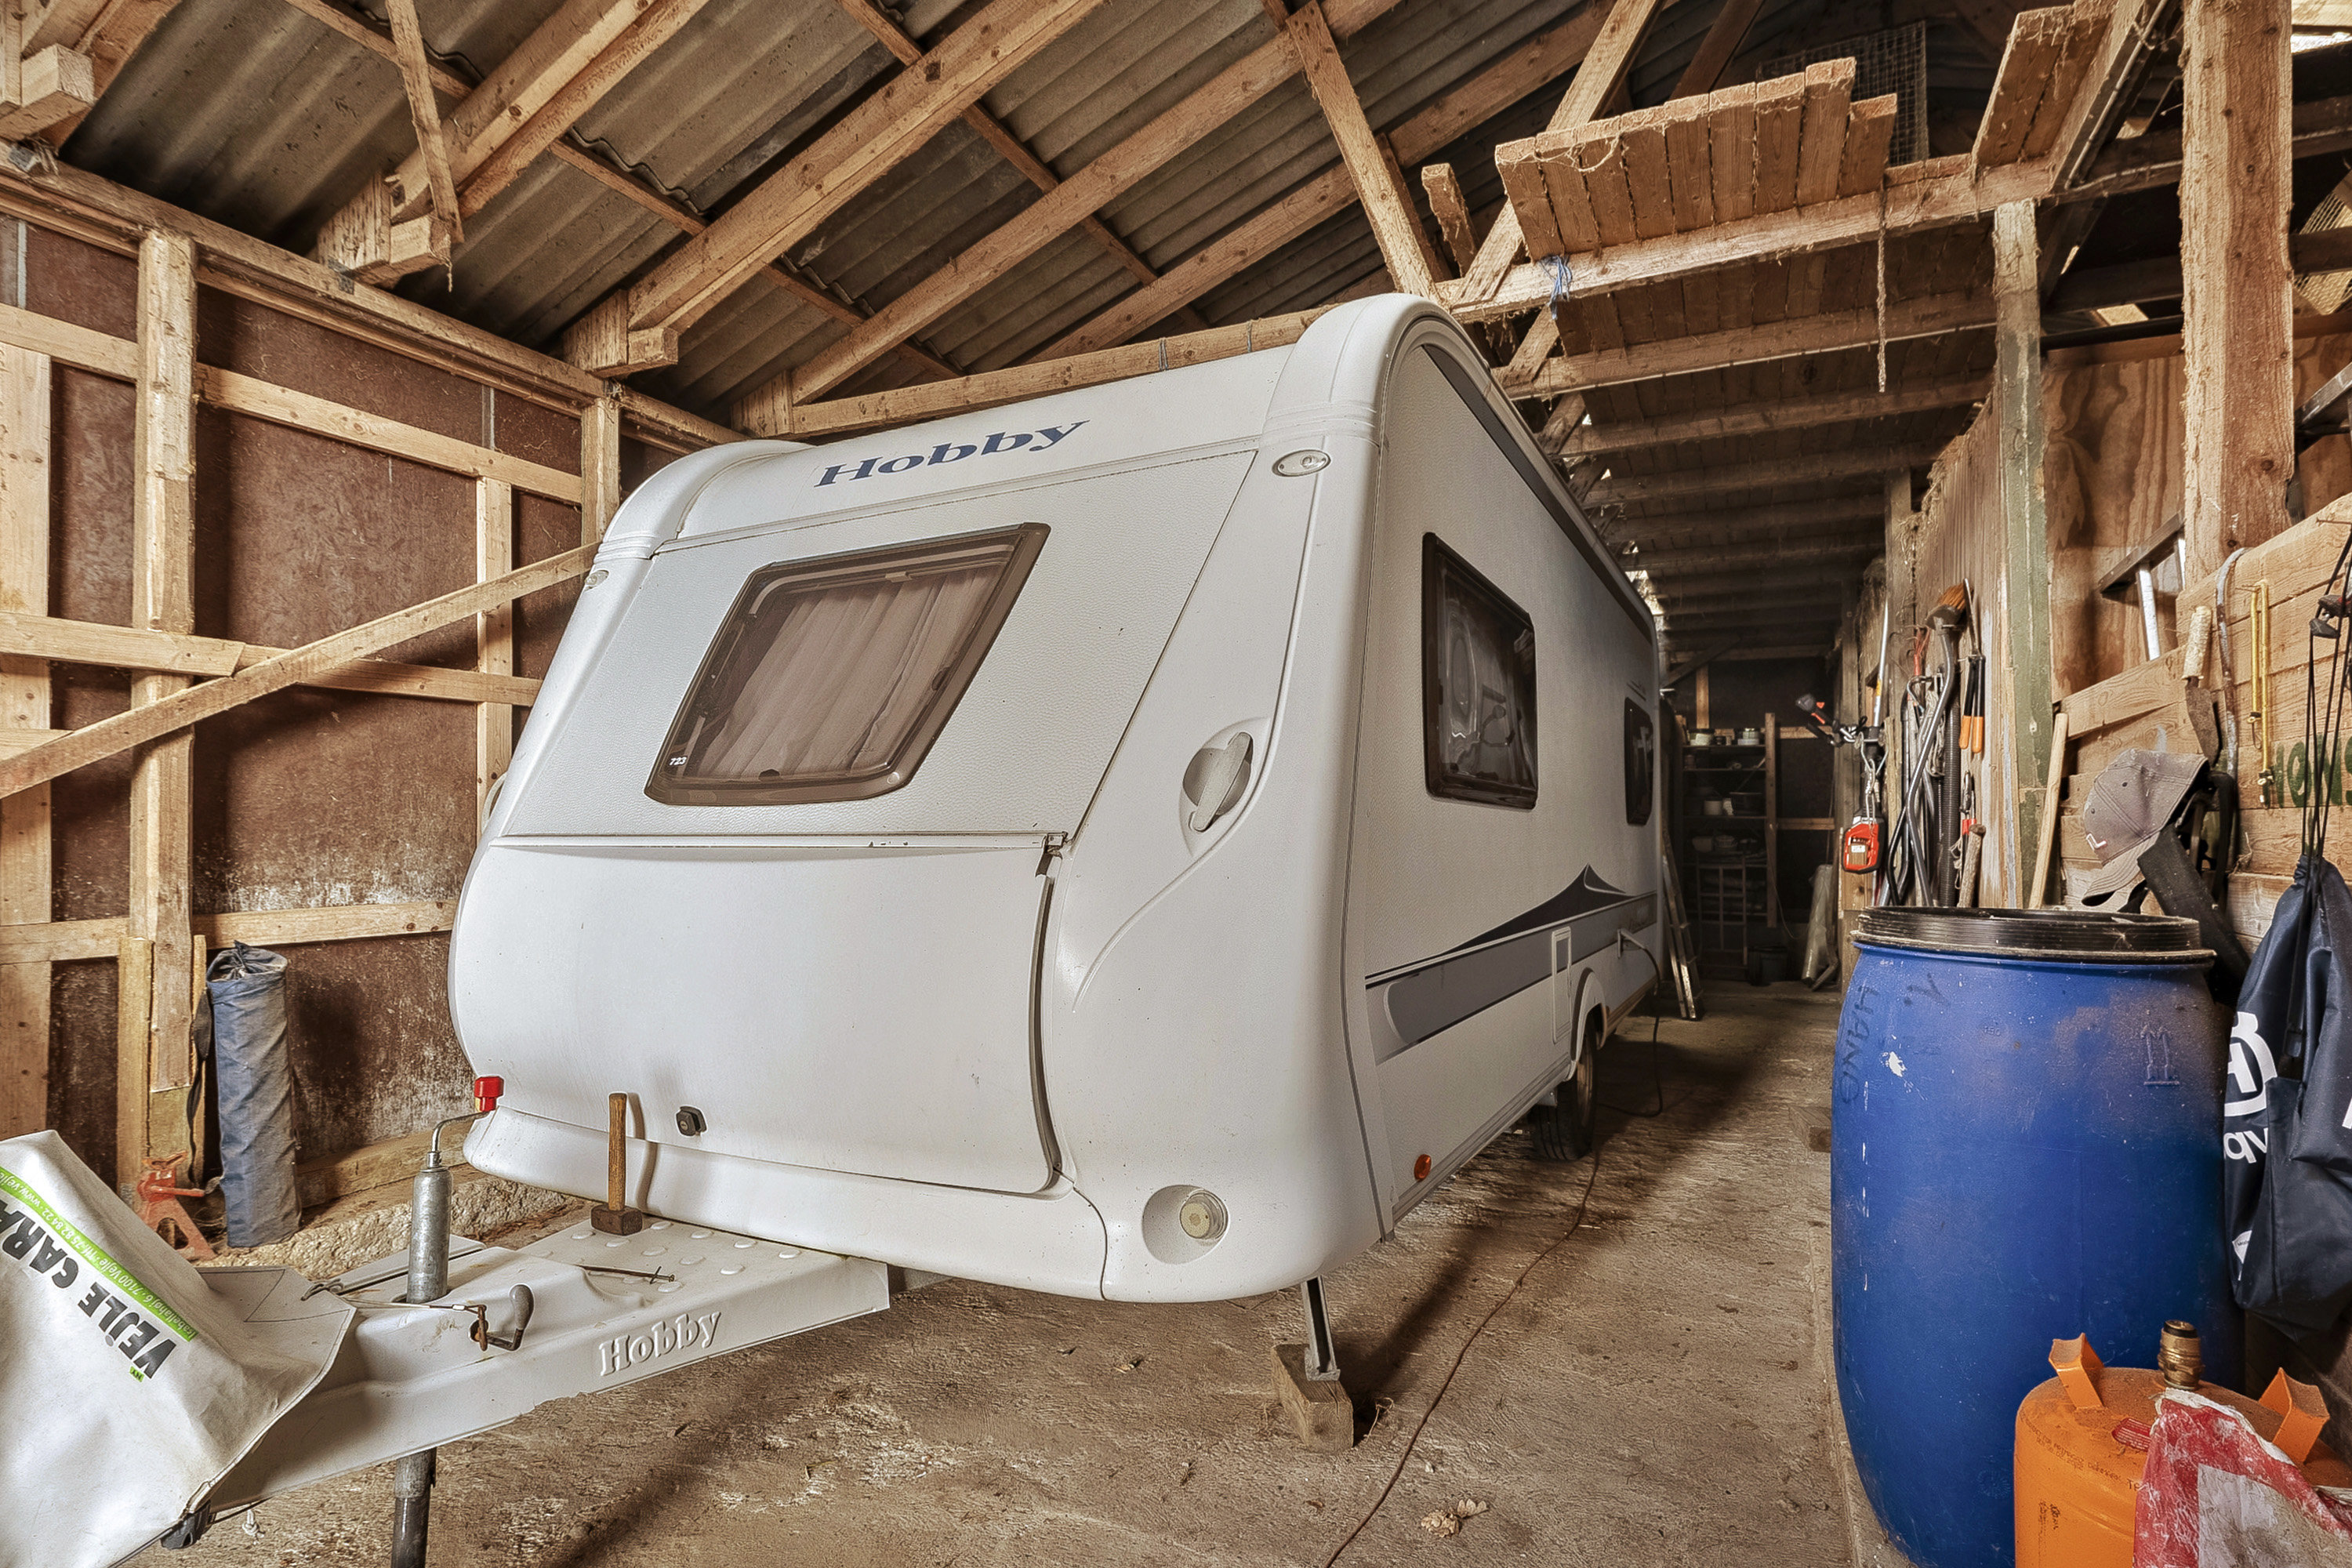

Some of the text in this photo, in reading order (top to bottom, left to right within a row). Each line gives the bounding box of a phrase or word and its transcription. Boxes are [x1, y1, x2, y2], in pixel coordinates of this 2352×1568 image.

[814, 419, 1091, 488] Hobby
[669, 756, 688, 766] 723
[42, 1208, 54, 1221] 22
[53, 1218, 64, 1229] 84
[61, 1228, 74, 1240] 82
[71, 1235, 84, 1250] 75
[100, 1258, 122, 1280] Vejle
[118, 1275, 143, 1295] 7100
[143, 1294, 154, 1303] 6
[598, 1311, 722, 1377] Hobby
